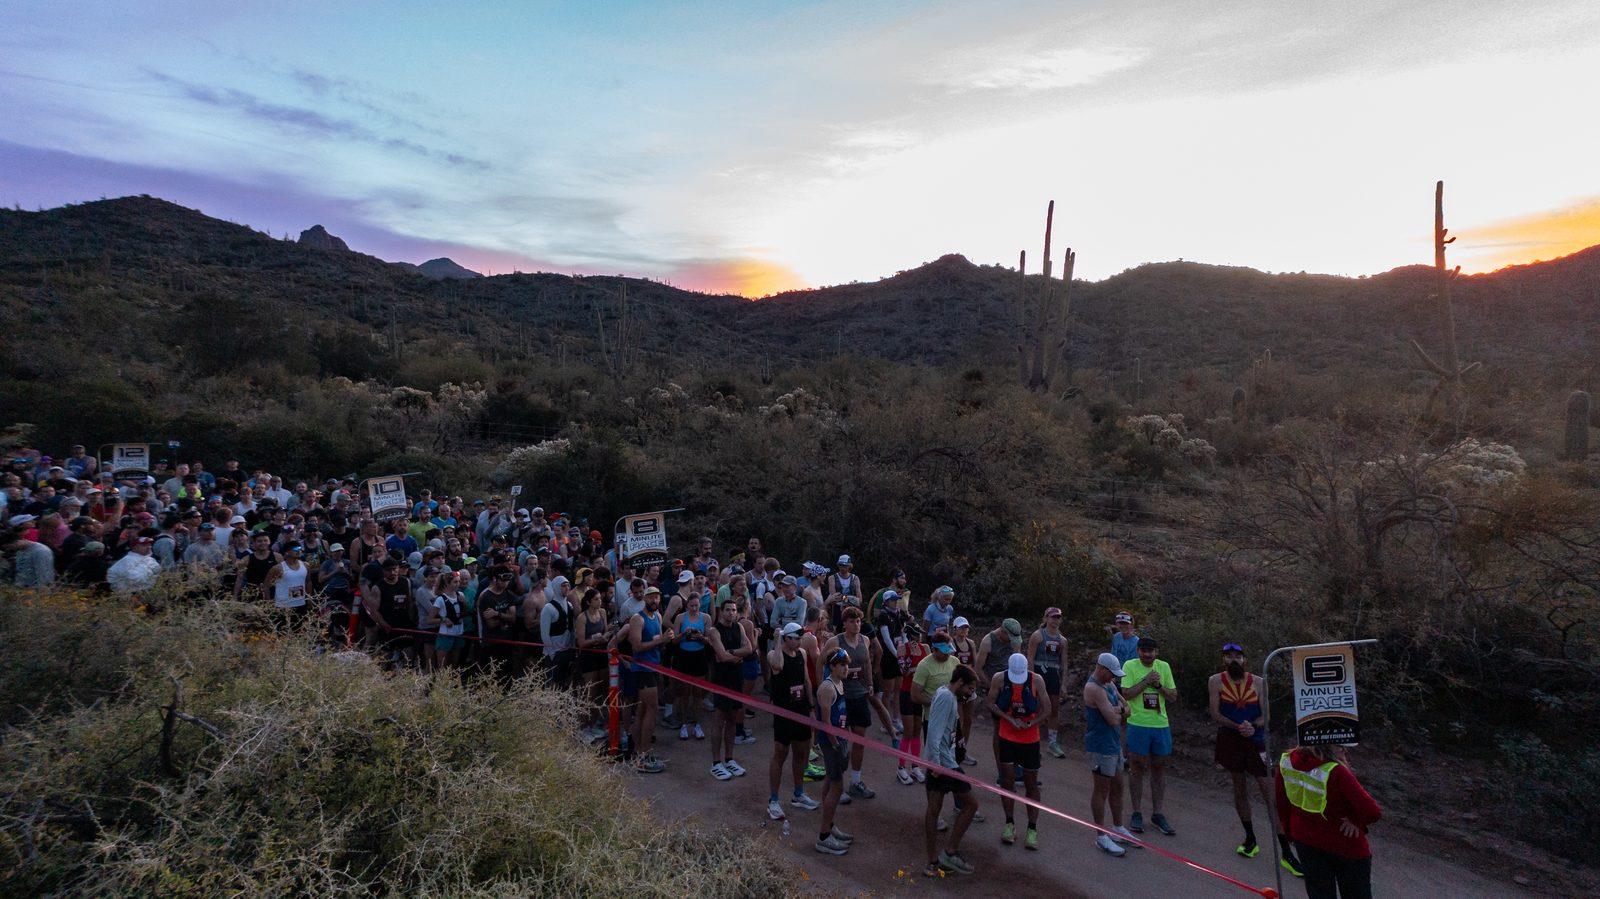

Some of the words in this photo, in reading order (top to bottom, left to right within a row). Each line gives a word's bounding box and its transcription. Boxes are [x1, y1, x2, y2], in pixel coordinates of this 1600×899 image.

[118, 447, 145, 457] 12
[372, 480, 402, 495] 10
[632, 517, 660, 536] 8
[630, 534, 663, 542] MINUTE
[630, 539, 665, 550] PACE
[1303, 654, 1347, 687] 6
[1301, 685, 1352, 697] MINUTE
[1300, 695, 1354, 711] PACE
